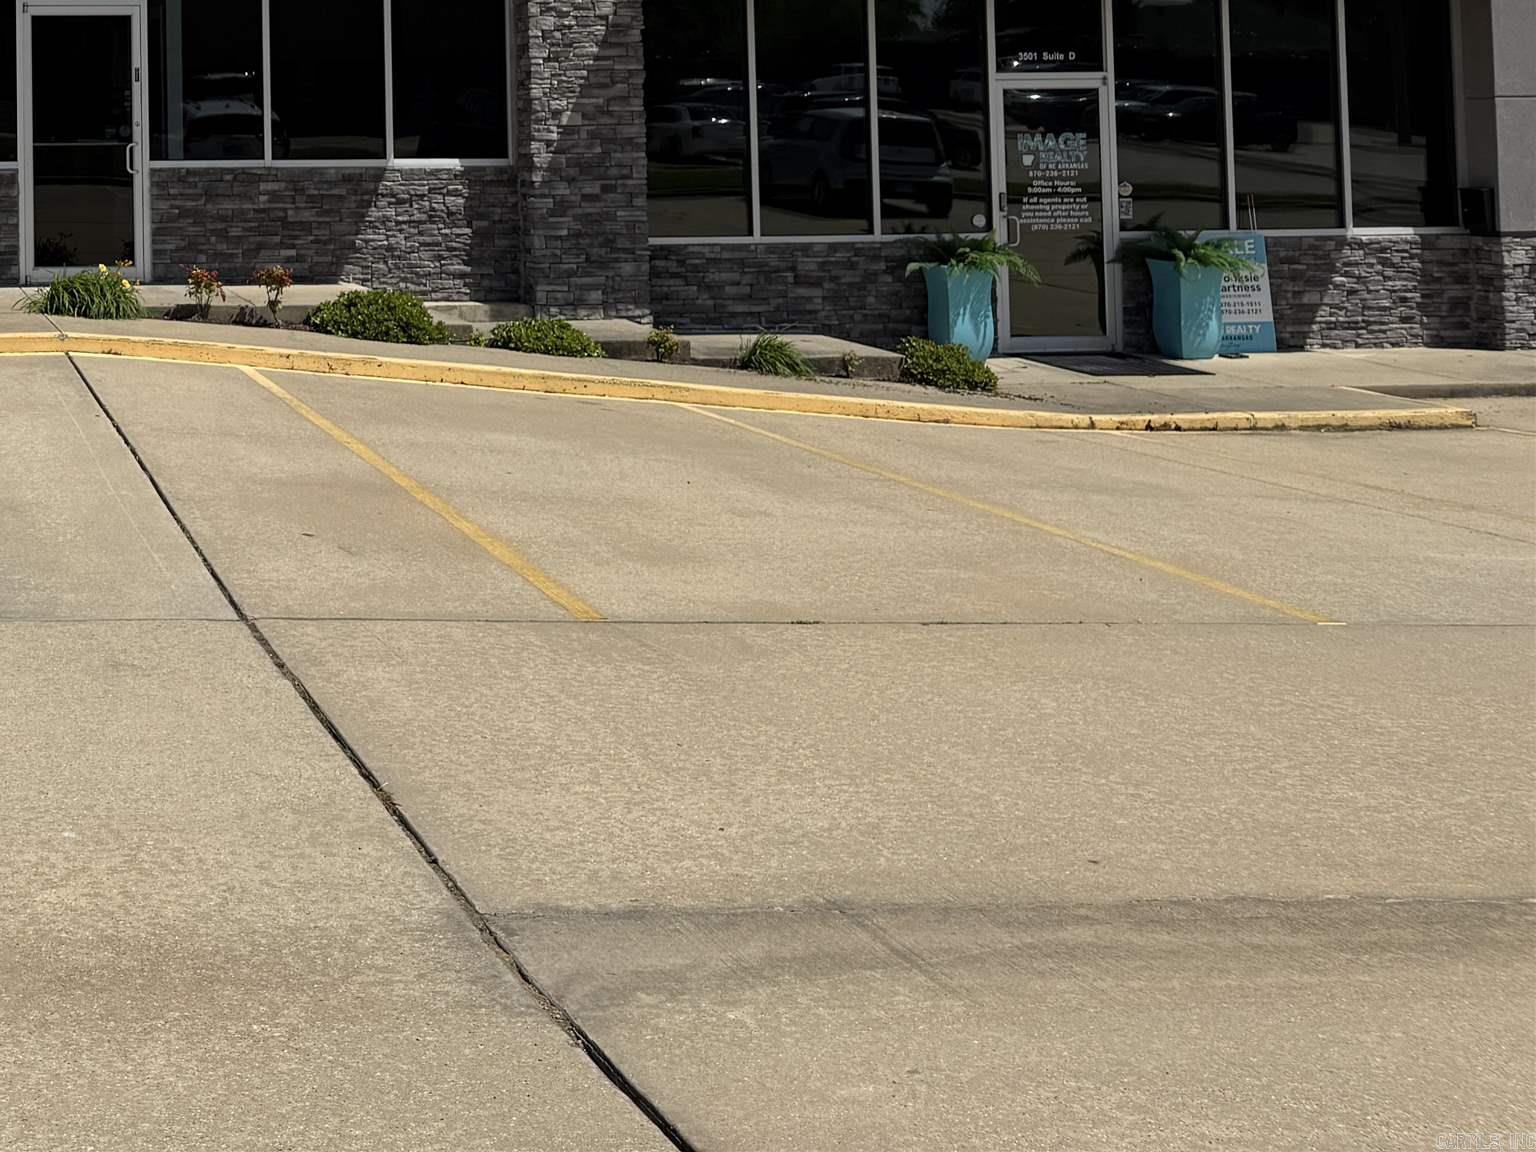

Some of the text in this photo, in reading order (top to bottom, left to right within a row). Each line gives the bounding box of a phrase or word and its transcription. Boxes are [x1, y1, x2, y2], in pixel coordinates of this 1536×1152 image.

[1018, 51, 1076, 61] 3501 Suite D
[1017, 132, 1087, 151] IMAGE
[1039, 151, 1088, 163] REALTY
[1221, 283, 1262, 293] artness
